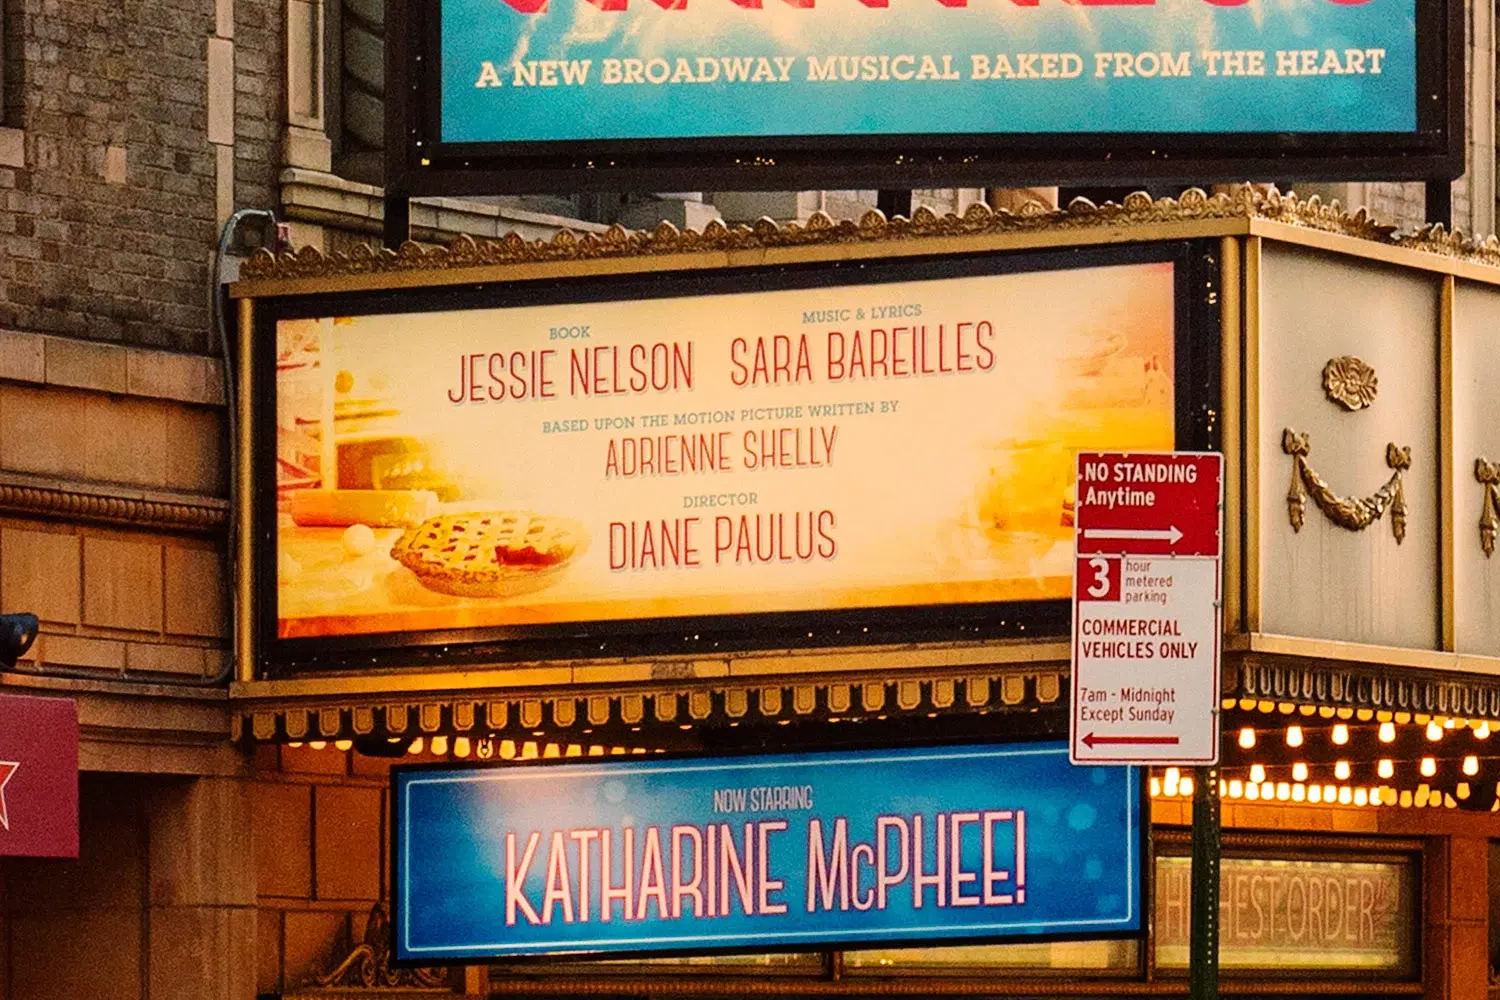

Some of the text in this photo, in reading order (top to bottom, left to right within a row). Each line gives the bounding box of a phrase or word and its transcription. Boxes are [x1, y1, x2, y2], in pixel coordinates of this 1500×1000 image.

[475, 49, 1386, 88] A NEW BROADWAY MUSICAL BAKED FROM THE HEART
[802, 304, 922, 324] MUSIC & LYRICS
[549, 326, 591, 340] BOOK
[731, 320, 994, 386] SARA BAREILLES
[448, 341, 693, 404] JESSIE NELSON
[543, 400, 899, 434] BASED UPON THE MOTION PICTURE WRITTEN BY
[605, 425, 836, 477] ADRIENNE SHELLY
[1085, 463, 1197, 483] NO STANDING
[683, 492, 758, 509] DIRECTOR
[1085, 486, 1155, 509] Anytime
[609, 510, 836, 570] DIANE PAULUS
[1126, 560, 1152, 571] hour
[1087, 559, 1111, 597] 3
[1126, 576, 1173, 587] metered
[1125, 591, 1167, 605] parking
[1082, 619, 1182, 636] COMMERCIAL
[1082, 642, 1198, 659] VEHICLES ONLY
[1081, 688, 1107, 702] 7am
[1120, 687, 1176, 706] Midnight
[1081, 707, 1175, 723] Except Sunday
[713, 785, 813, 813] NOW STARRING
[505, 809, 1026, 927] KATHARINE McPHEE!
[1166, 875, 1280, 938] HIHEST
